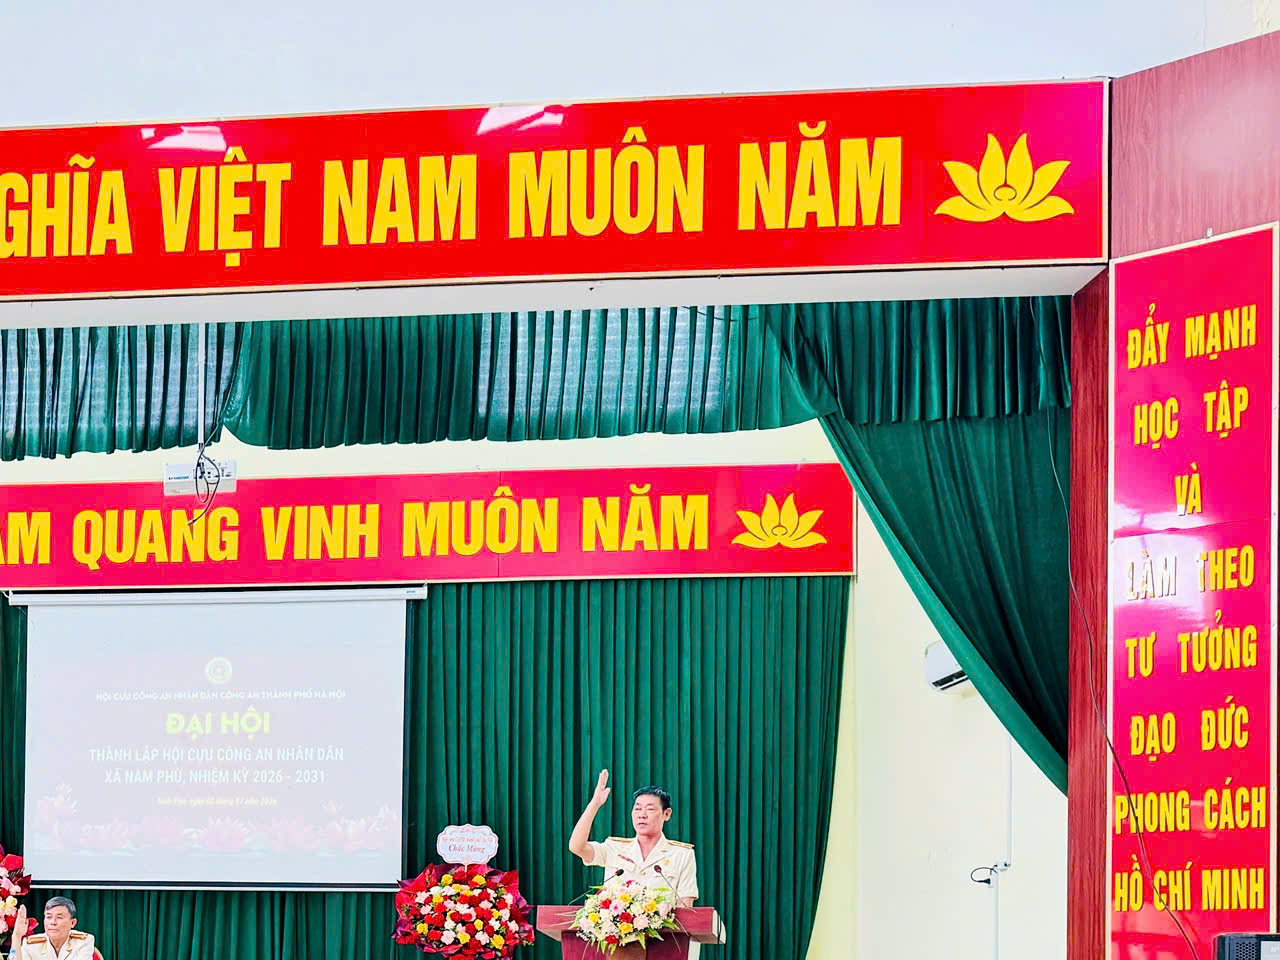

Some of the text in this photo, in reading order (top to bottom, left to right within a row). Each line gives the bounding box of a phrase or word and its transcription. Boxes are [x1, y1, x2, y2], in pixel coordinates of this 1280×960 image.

[158, 146, 292, 267] VIỆT
[323, 154, 477, 246] NAM
[508, 127, 705, 239] MUÔN
[737, 121, 902, 231] NĂM
[1126, 303, 1257, 369] ĐẨY MẠNH
[1134, 379, 1249, 449] HỌC TẬP
[1174, 461, 1202, 515] VÀ
[72, 506, 239, 571] QUANG
[260, 503, 380, 561] VINH
[402, 485, 559, 557] MUÔN
[582, 483, 709, 553] NĂM
[1127, 545, 1255, 600] LÀM THEO
[1125, 609, 1257, 678] TƯ TƯỞNG
[165, 704, 271, 740] ĐẠI HỘI
[1130, 696, 1249, 762] ĐẠO ĐỨC
[89, 745, 132, 761] THÀNH
[163, 745, 184, 764] HỘI
[217, 745, 252, 761] CÔNG
[255, 748, 273, 761] AN
[277, 745, 313, 761] NHÂN
[317, 745, 344, 761] DÂN
[104, 767, 121, 784] XÃ
[125, 769, 153, 784] NAM
[253, 769, 283, 784] 2026
[295, 769, 325, 784] 2031
[1114, 777, 1266, 834] PHONG CÁCH
[1114, 854, 1265, 912] HỒ CHÍ MINH
